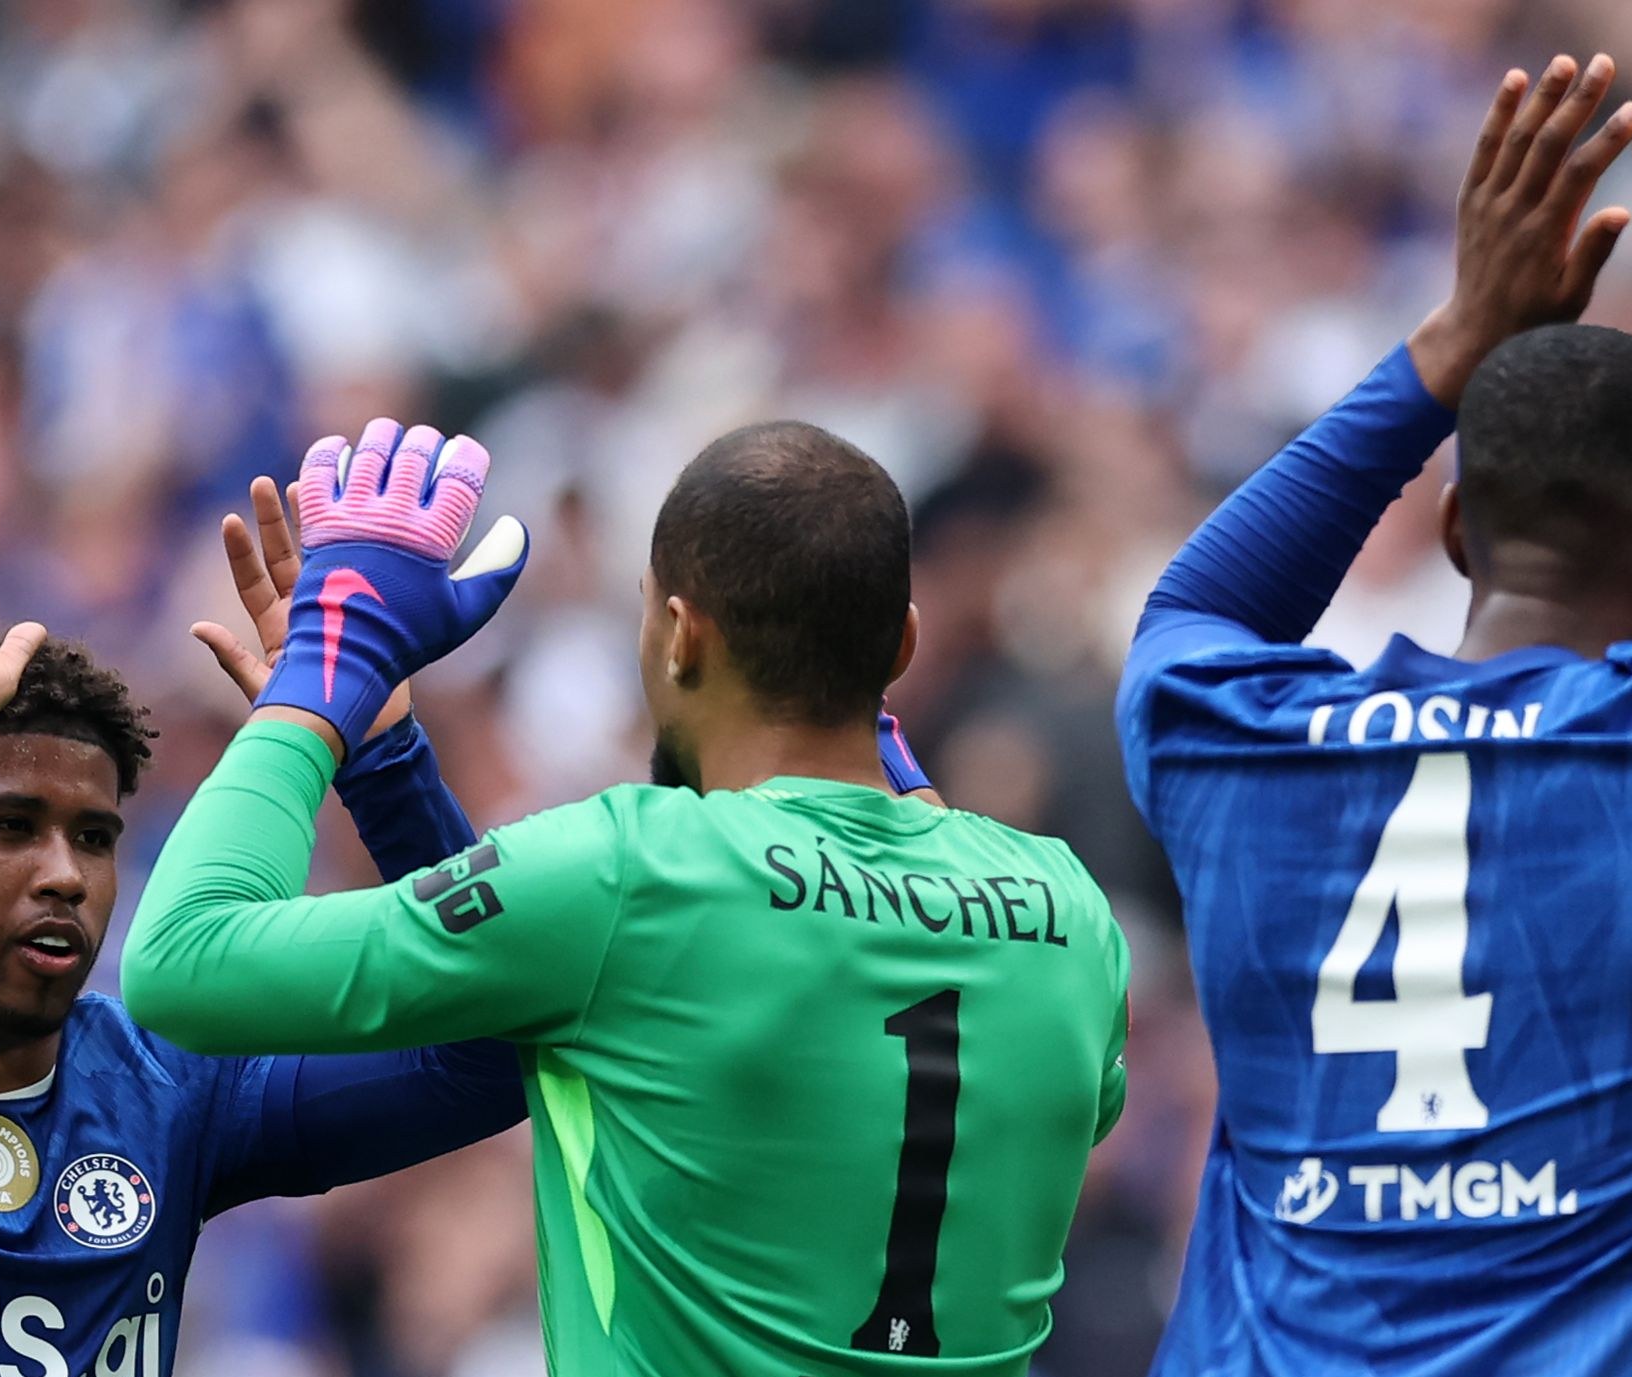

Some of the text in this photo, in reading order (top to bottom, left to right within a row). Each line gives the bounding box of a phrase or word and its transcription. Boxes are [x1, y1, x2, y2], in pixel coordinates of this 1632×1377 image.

[765, 837, 1068, 948] SÁNCHEZ
[1312, 752, 1494, 1133] 4
[61, 1157, 119, 1191] CHELSEA
[850, 988, 961, 1358] 1
[88, 1232, 132, 1245] FOOTBALL
